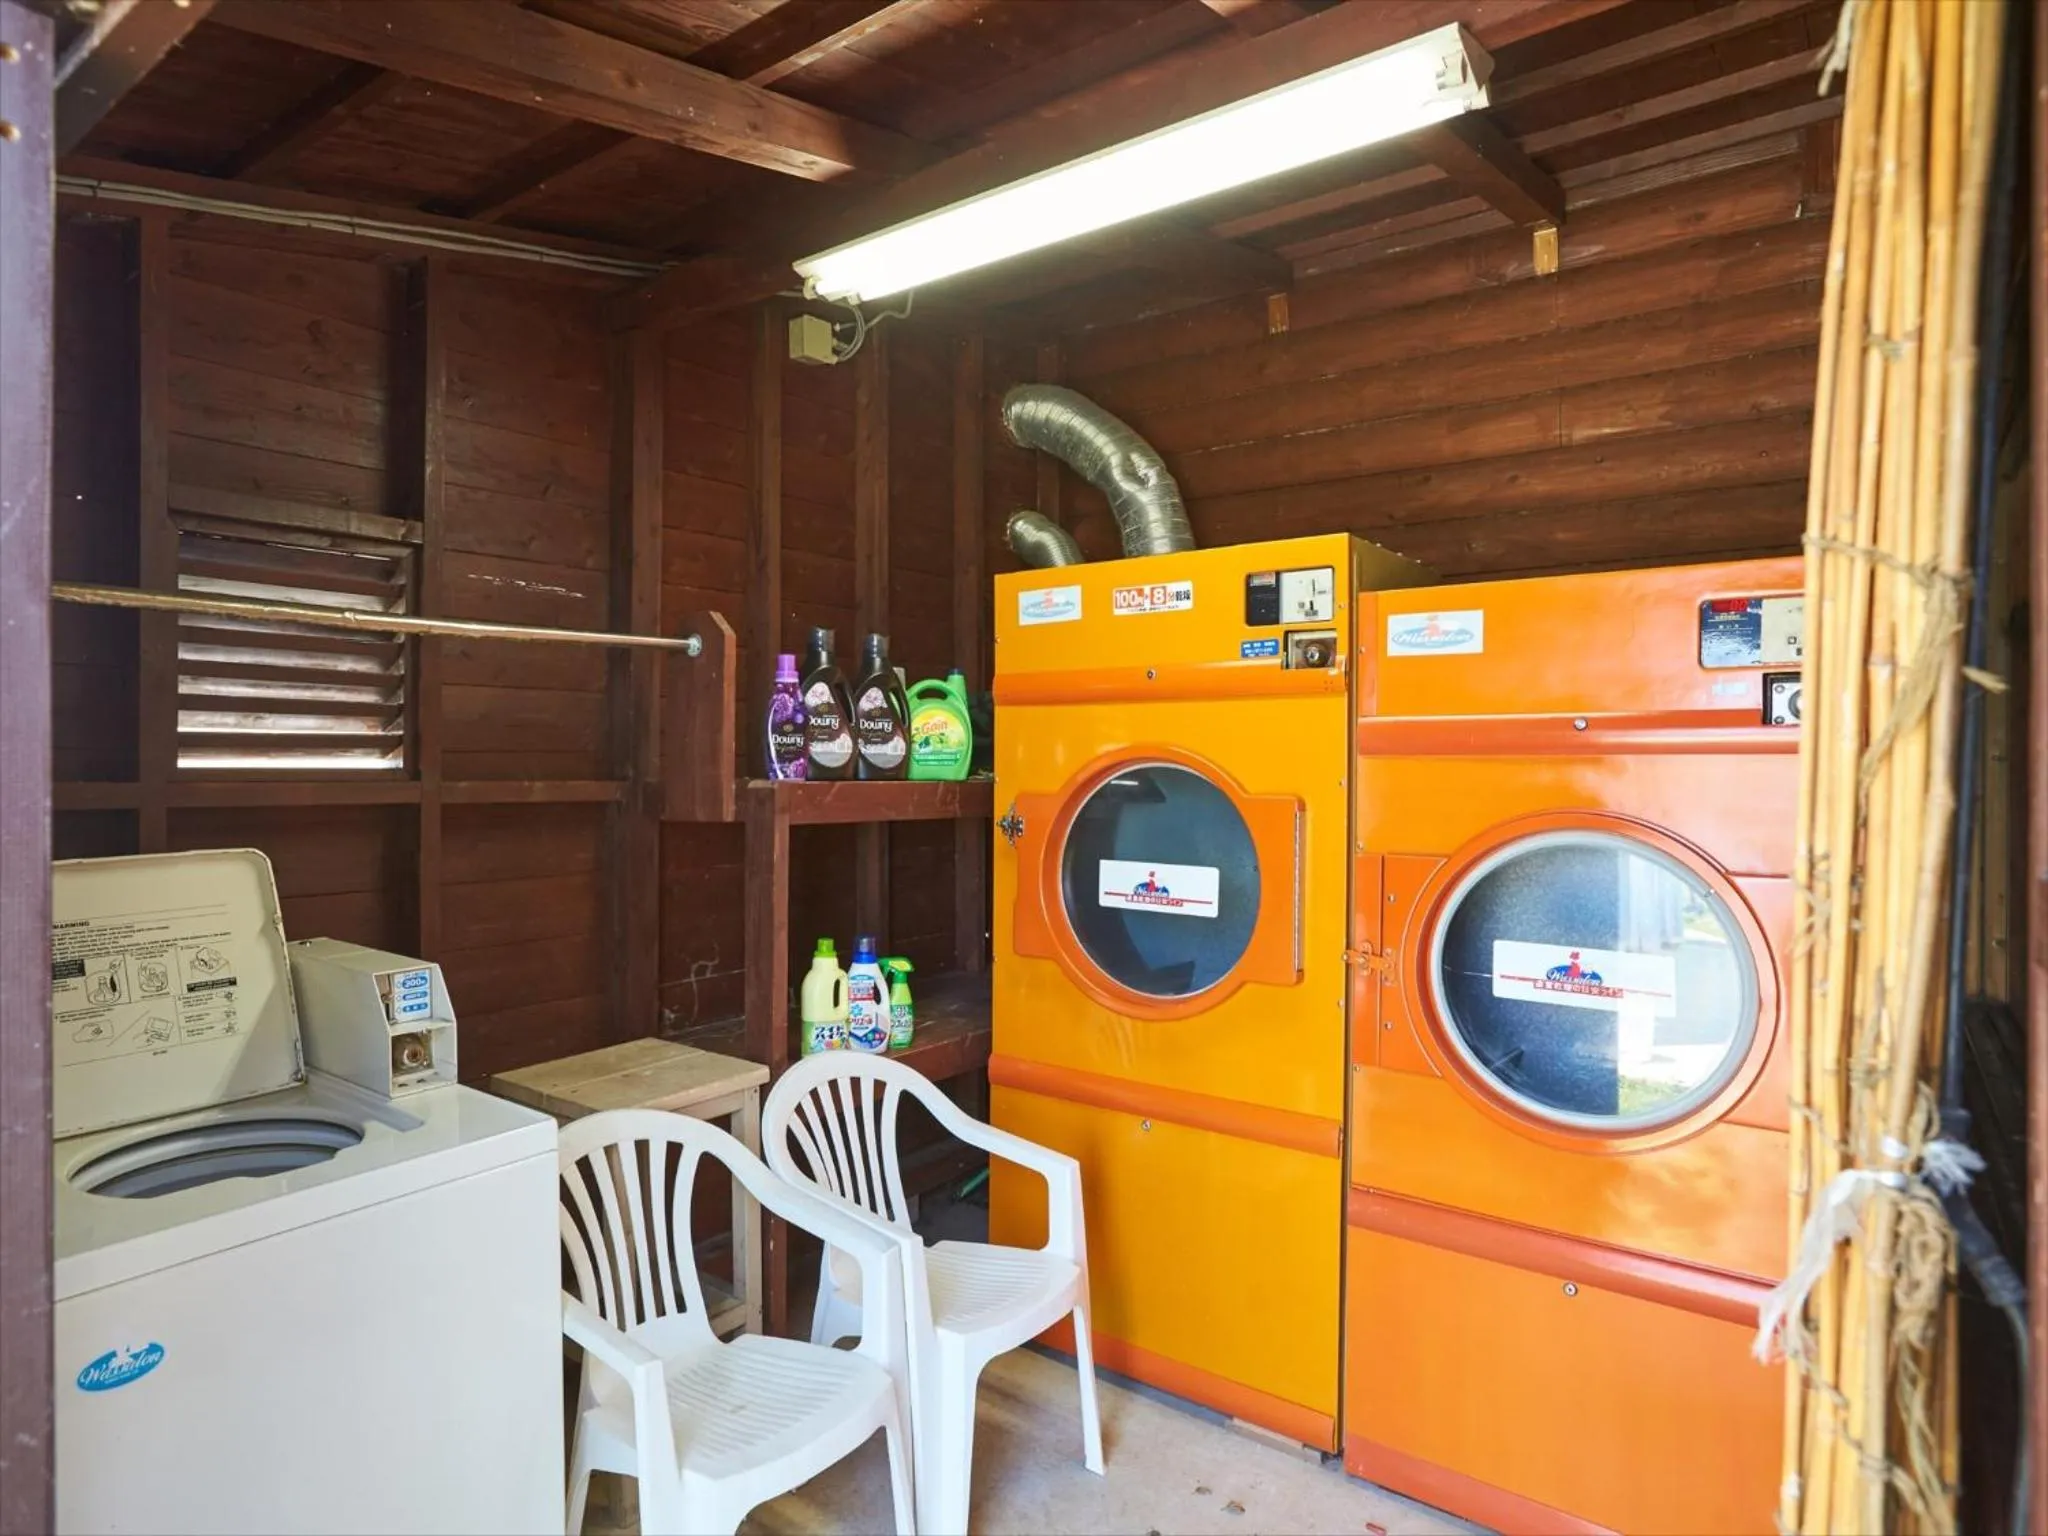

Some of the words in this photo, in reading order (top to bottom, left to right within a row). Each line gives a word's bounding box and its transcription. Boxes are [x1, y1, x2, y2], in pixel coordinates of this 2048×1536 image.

[859, 718, 893, 732] Downy
[921, 720, 948, 735] Gain
[773, 733, 804, 746] Downy
